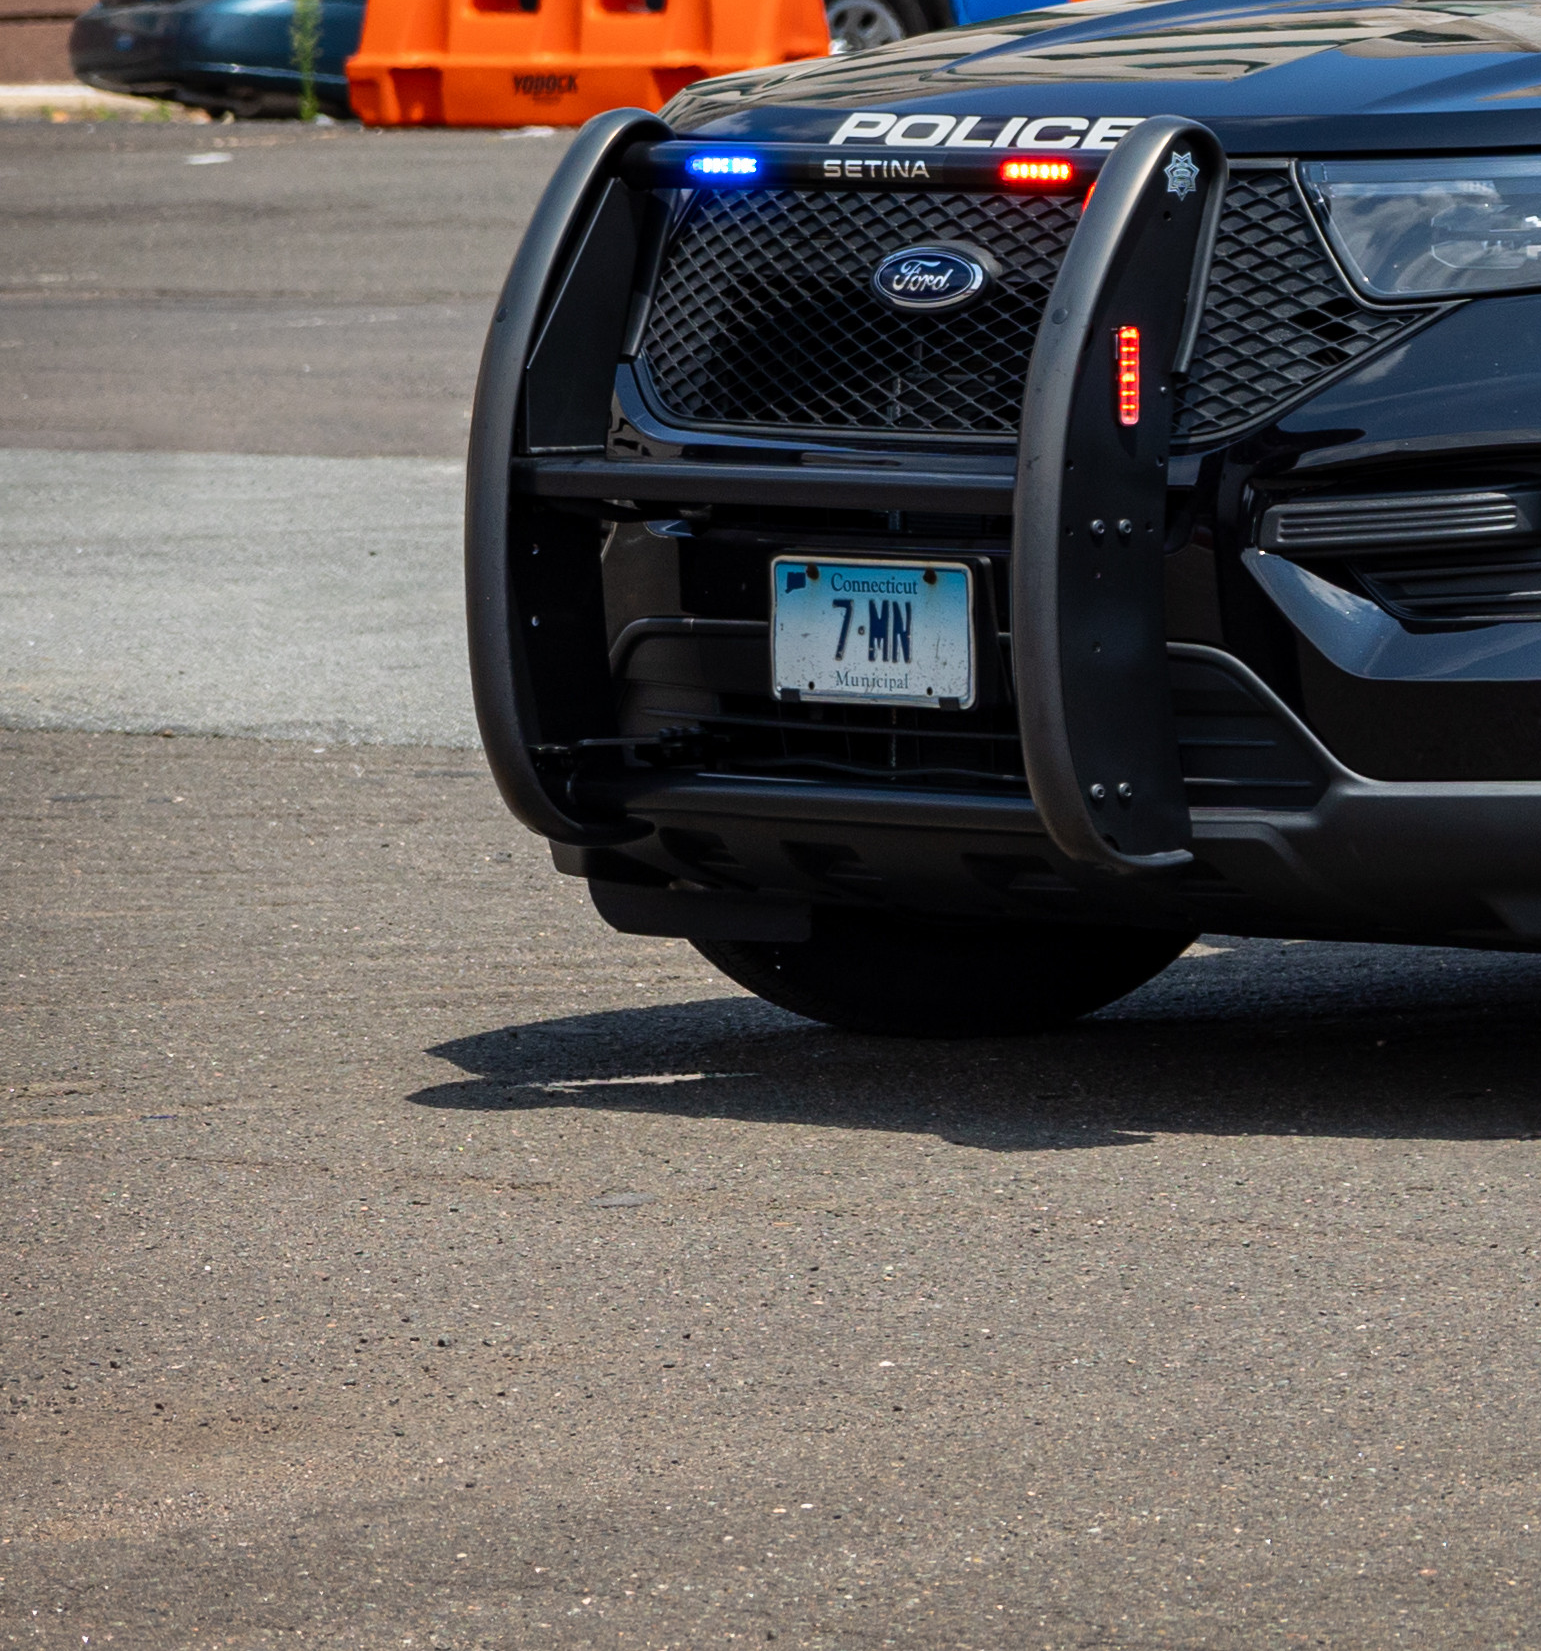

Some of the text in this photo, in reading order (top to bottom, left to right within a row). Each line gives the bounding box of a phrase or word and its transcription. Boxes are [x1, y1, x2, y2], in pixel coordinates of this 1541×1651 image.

[513, 75, 578, 95] YODOCK
[828, 112, 1147, 150] POLICE
[823, 159, 930, 179] SETINA
[893, 260, 952, 292] Ford
[831, 572, 919, 595] Connecticut
[835, 670, 910, 692] Municipal
